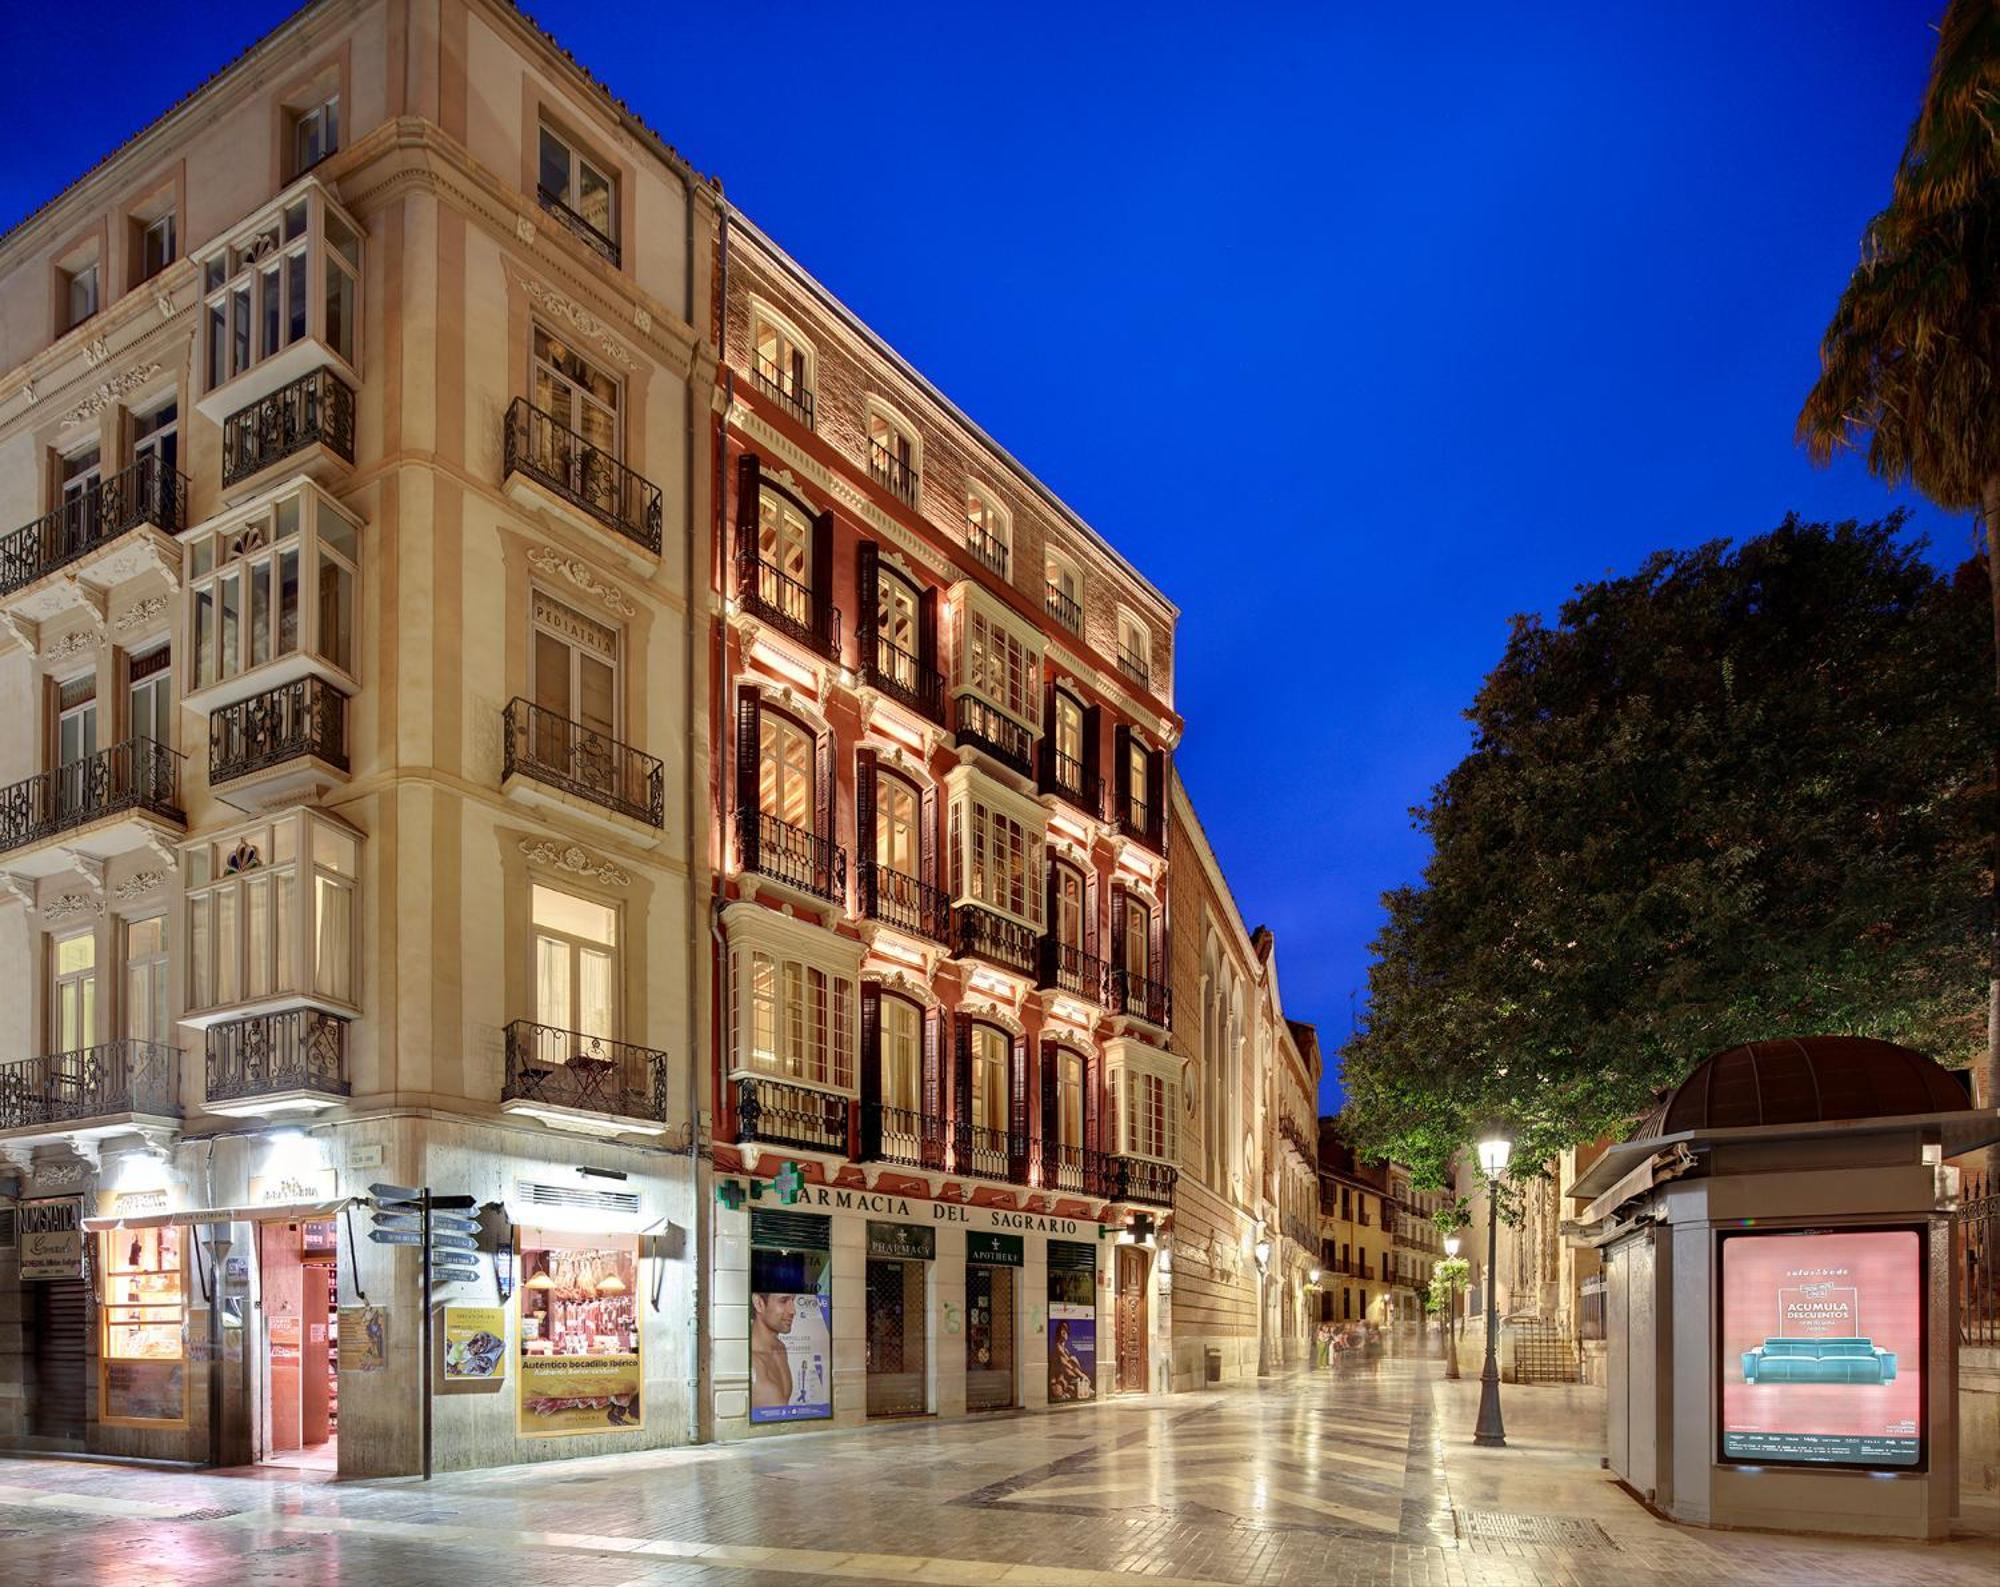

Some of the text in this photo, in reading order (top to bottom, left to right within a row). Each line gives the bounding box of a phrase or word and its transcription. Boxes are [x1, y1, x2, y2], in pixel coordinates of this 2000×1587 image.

[536, 606, 611, 653] PEDIATRIA
[797, 1187, 1077, 1234] ARMACIA DEL SAGRARIO
[1787, 1303, 1848, 1311] ACUMULA
[1787, 1311, 1849, 1319] DESCUENTOS
[569, 1360, 608, 1368] bocadillo
